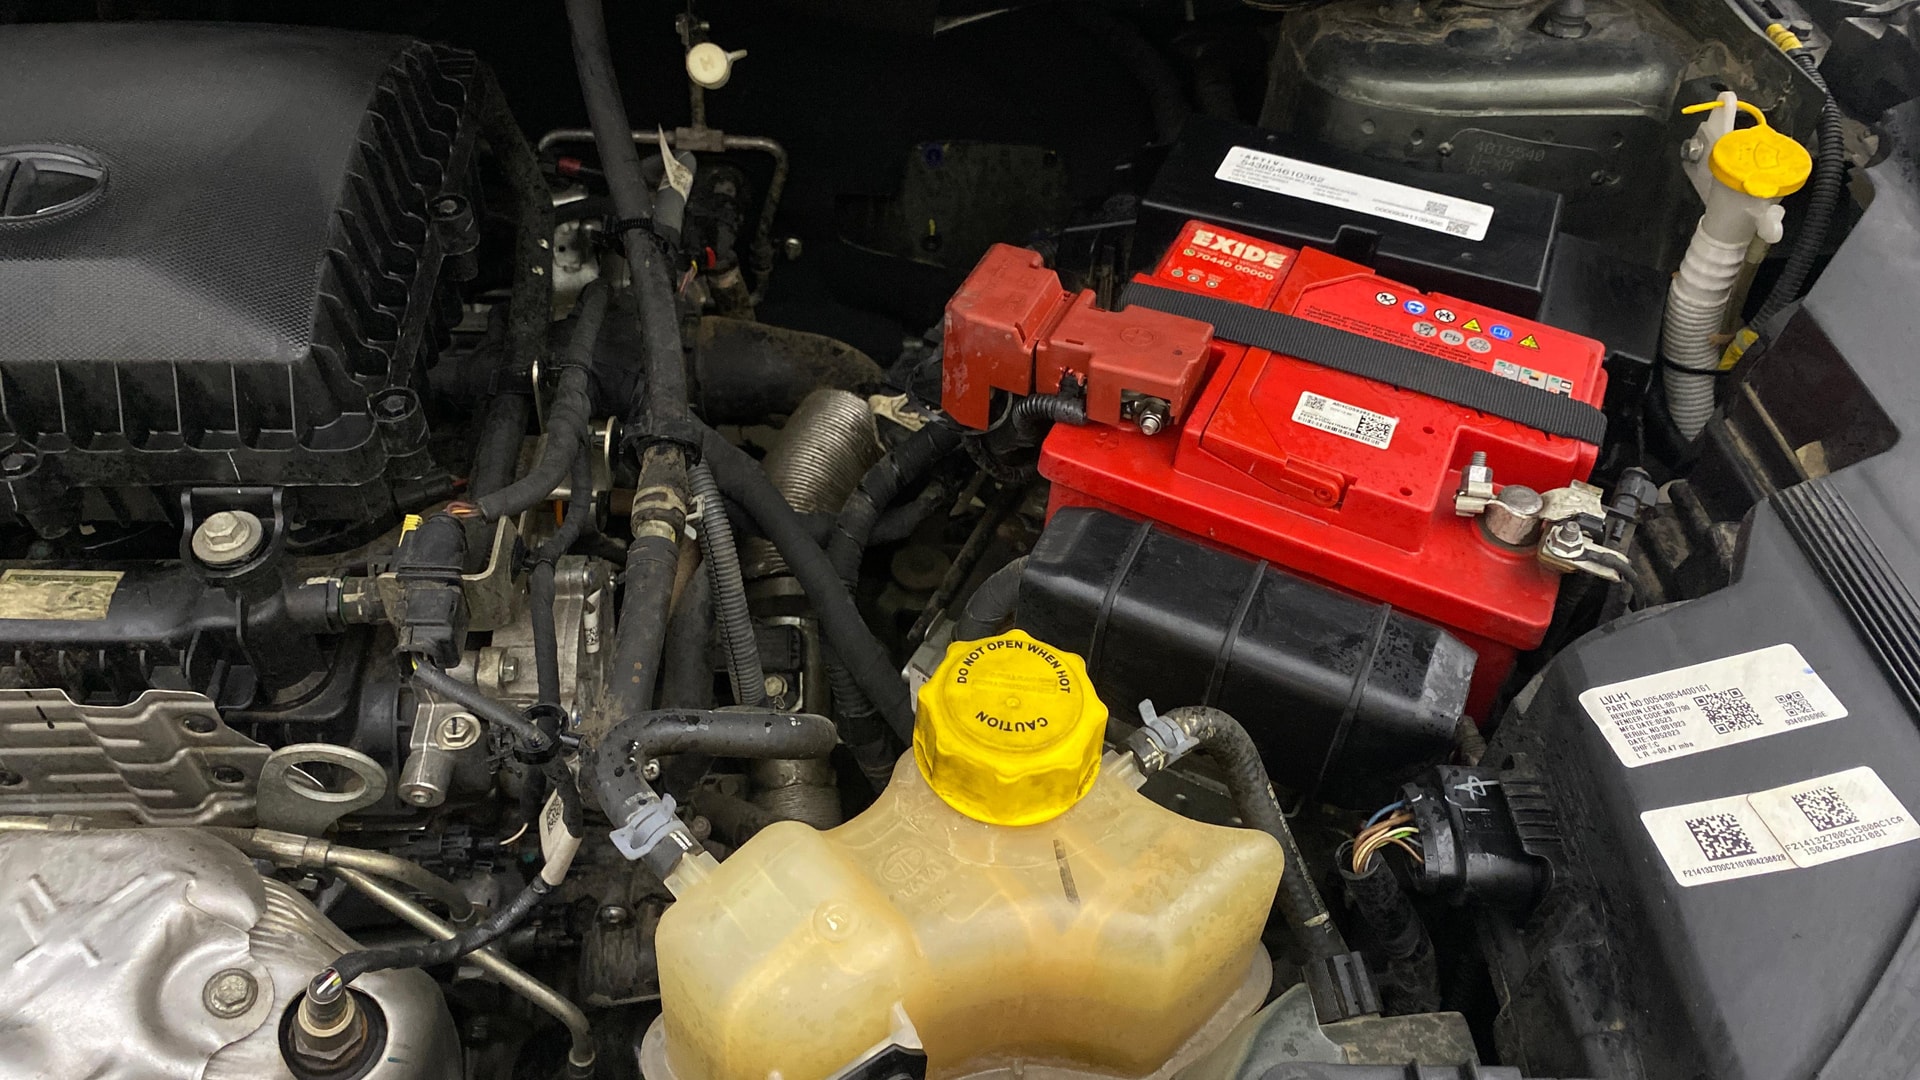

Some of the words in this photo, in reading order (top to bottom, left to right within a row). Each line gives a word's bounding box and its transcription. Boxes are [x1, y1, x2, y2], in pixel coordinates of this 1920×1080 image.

[1191, 229, 1288, 269] EXIDE
[1196, 251, 1232, 267] 70440
[1234, 264, 1274, 280] 00000
[1443, 332, 1461, 342] Pb
[957, 667, 969, 684] DO
[964, 646, 986, 669] NOT
[986, 640, 1023, 651] OPEN
[1027, 643, 1062, 669] WHEN
[1056, 670, 1071, 694] HOT
[1599, 691, 1632, 706] LVLH1
[1605, 703, 1629, 714] PART
[1610, 708, 1643, 721] REVISION
[975, 711, 1049, 733] CAUTION
[1614, 716, 1643, 727] VENDER
[1619, 724, 1636, 733] MFG
[1623, 730, 1649, 740] SERIAL
